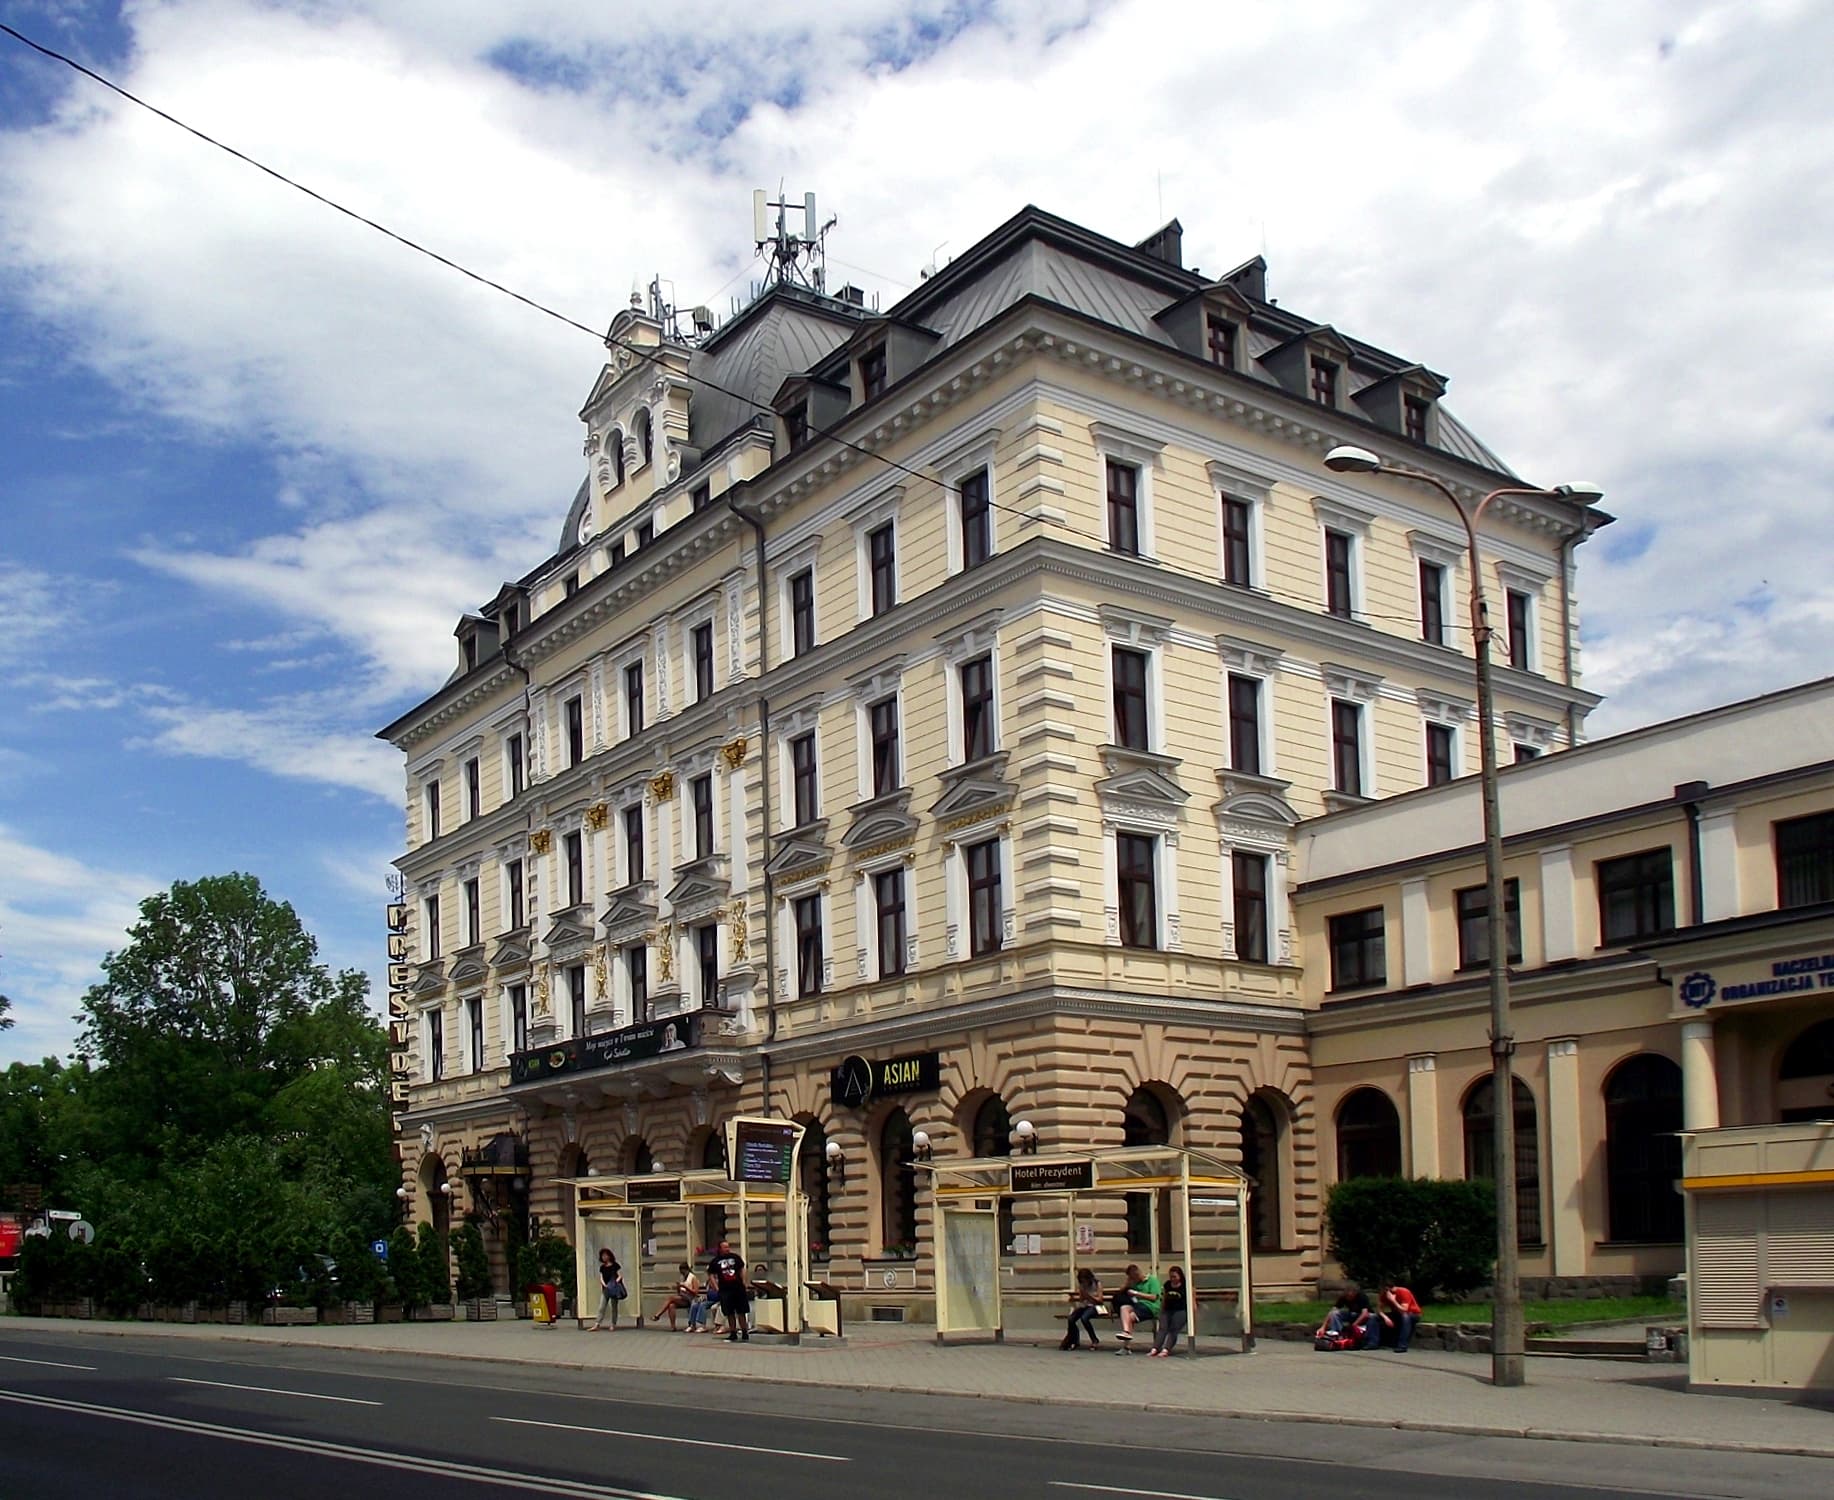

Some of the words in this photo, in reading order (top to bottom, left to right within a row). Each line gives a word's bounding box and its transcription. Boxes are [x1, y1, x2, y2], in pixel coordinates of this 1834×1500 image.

[1721, 976, 1813, 1000] ORGANIZACJA
[884, 1060, 919, 1085] ASIAN
[1015, 1168, 1037, 1178] Hotel
[1039, 1166, 1081, 1178] Prezydent
